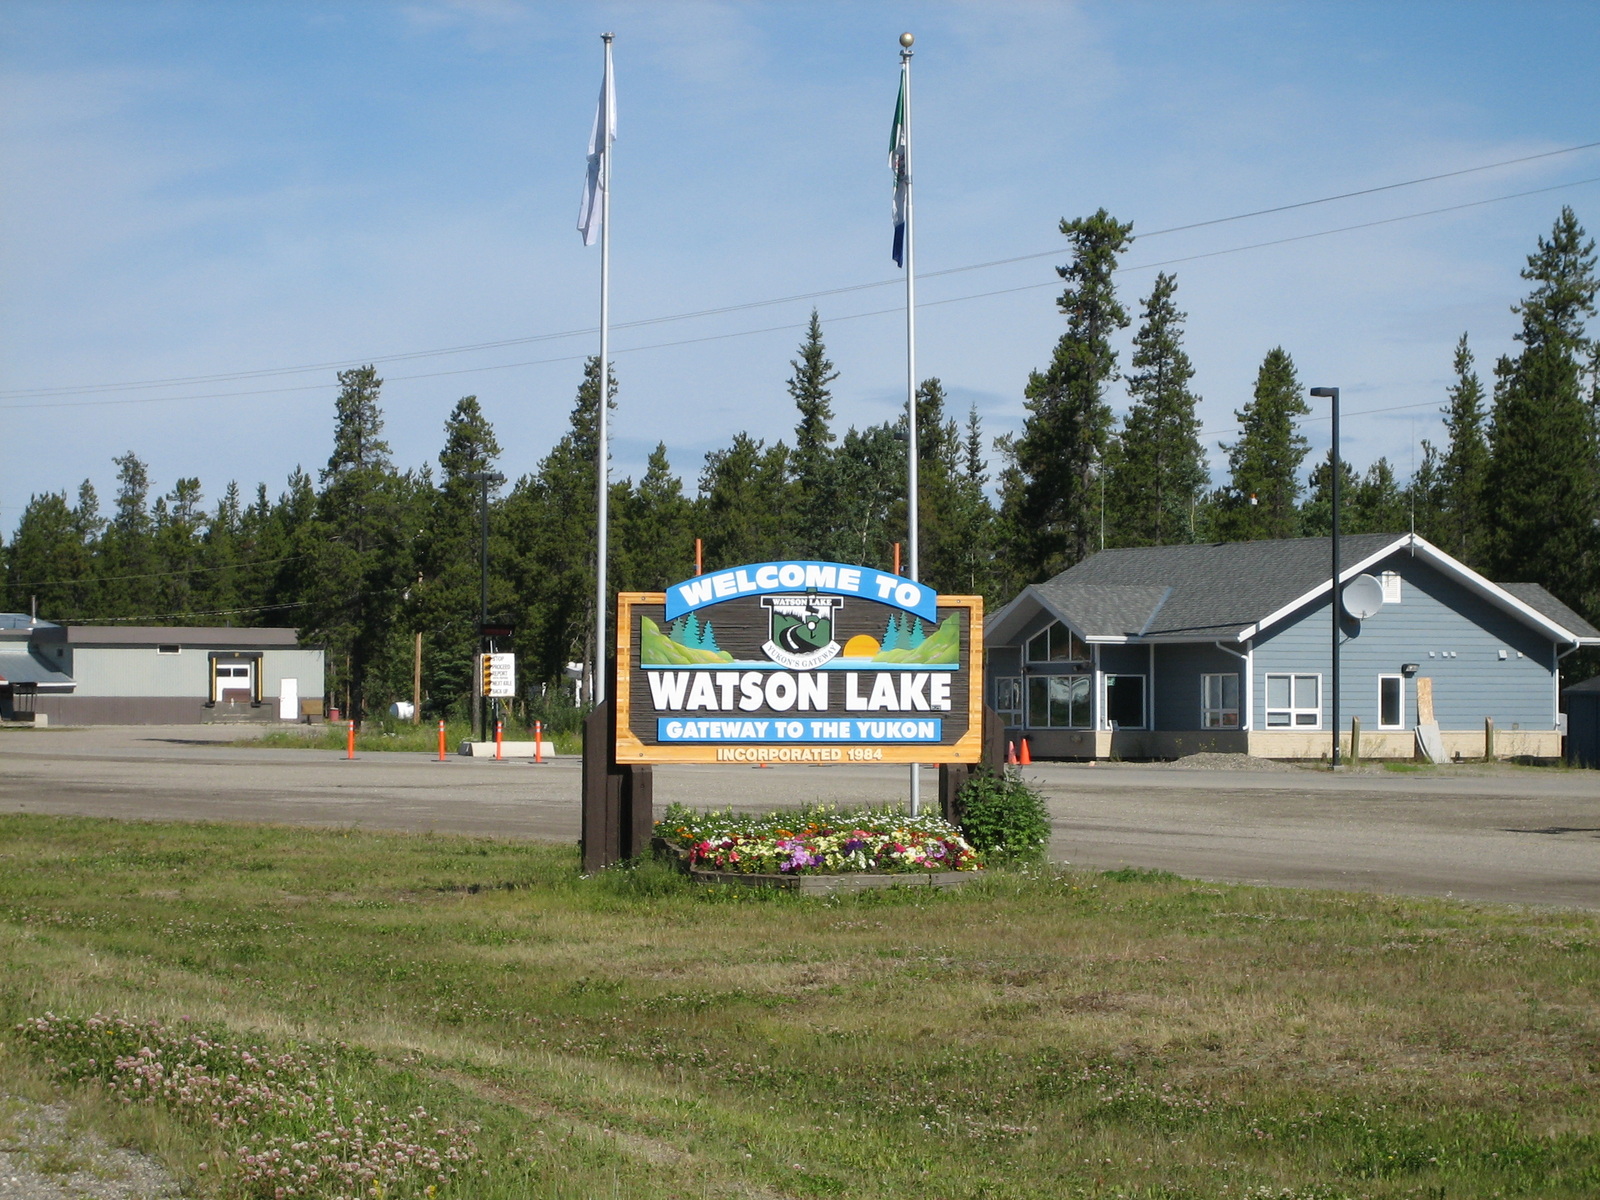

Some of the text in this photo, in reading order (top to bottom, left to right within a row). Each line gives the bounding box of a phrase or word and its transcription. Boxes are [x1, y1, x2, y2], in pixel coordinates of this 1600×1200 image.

[678, 564, 921, 608] WELCOME TO
[772, 598, 833, 606] WATSON LAKE
[767, 644, 837, 668] YUKON'S GATEWAY
[647, 671, 952, 712] WATSON LAKE
[666, 721, 935, 739] GATEWAY TO THE YUKON
[716, 748, 883, 761] INCORPORATED 1984
